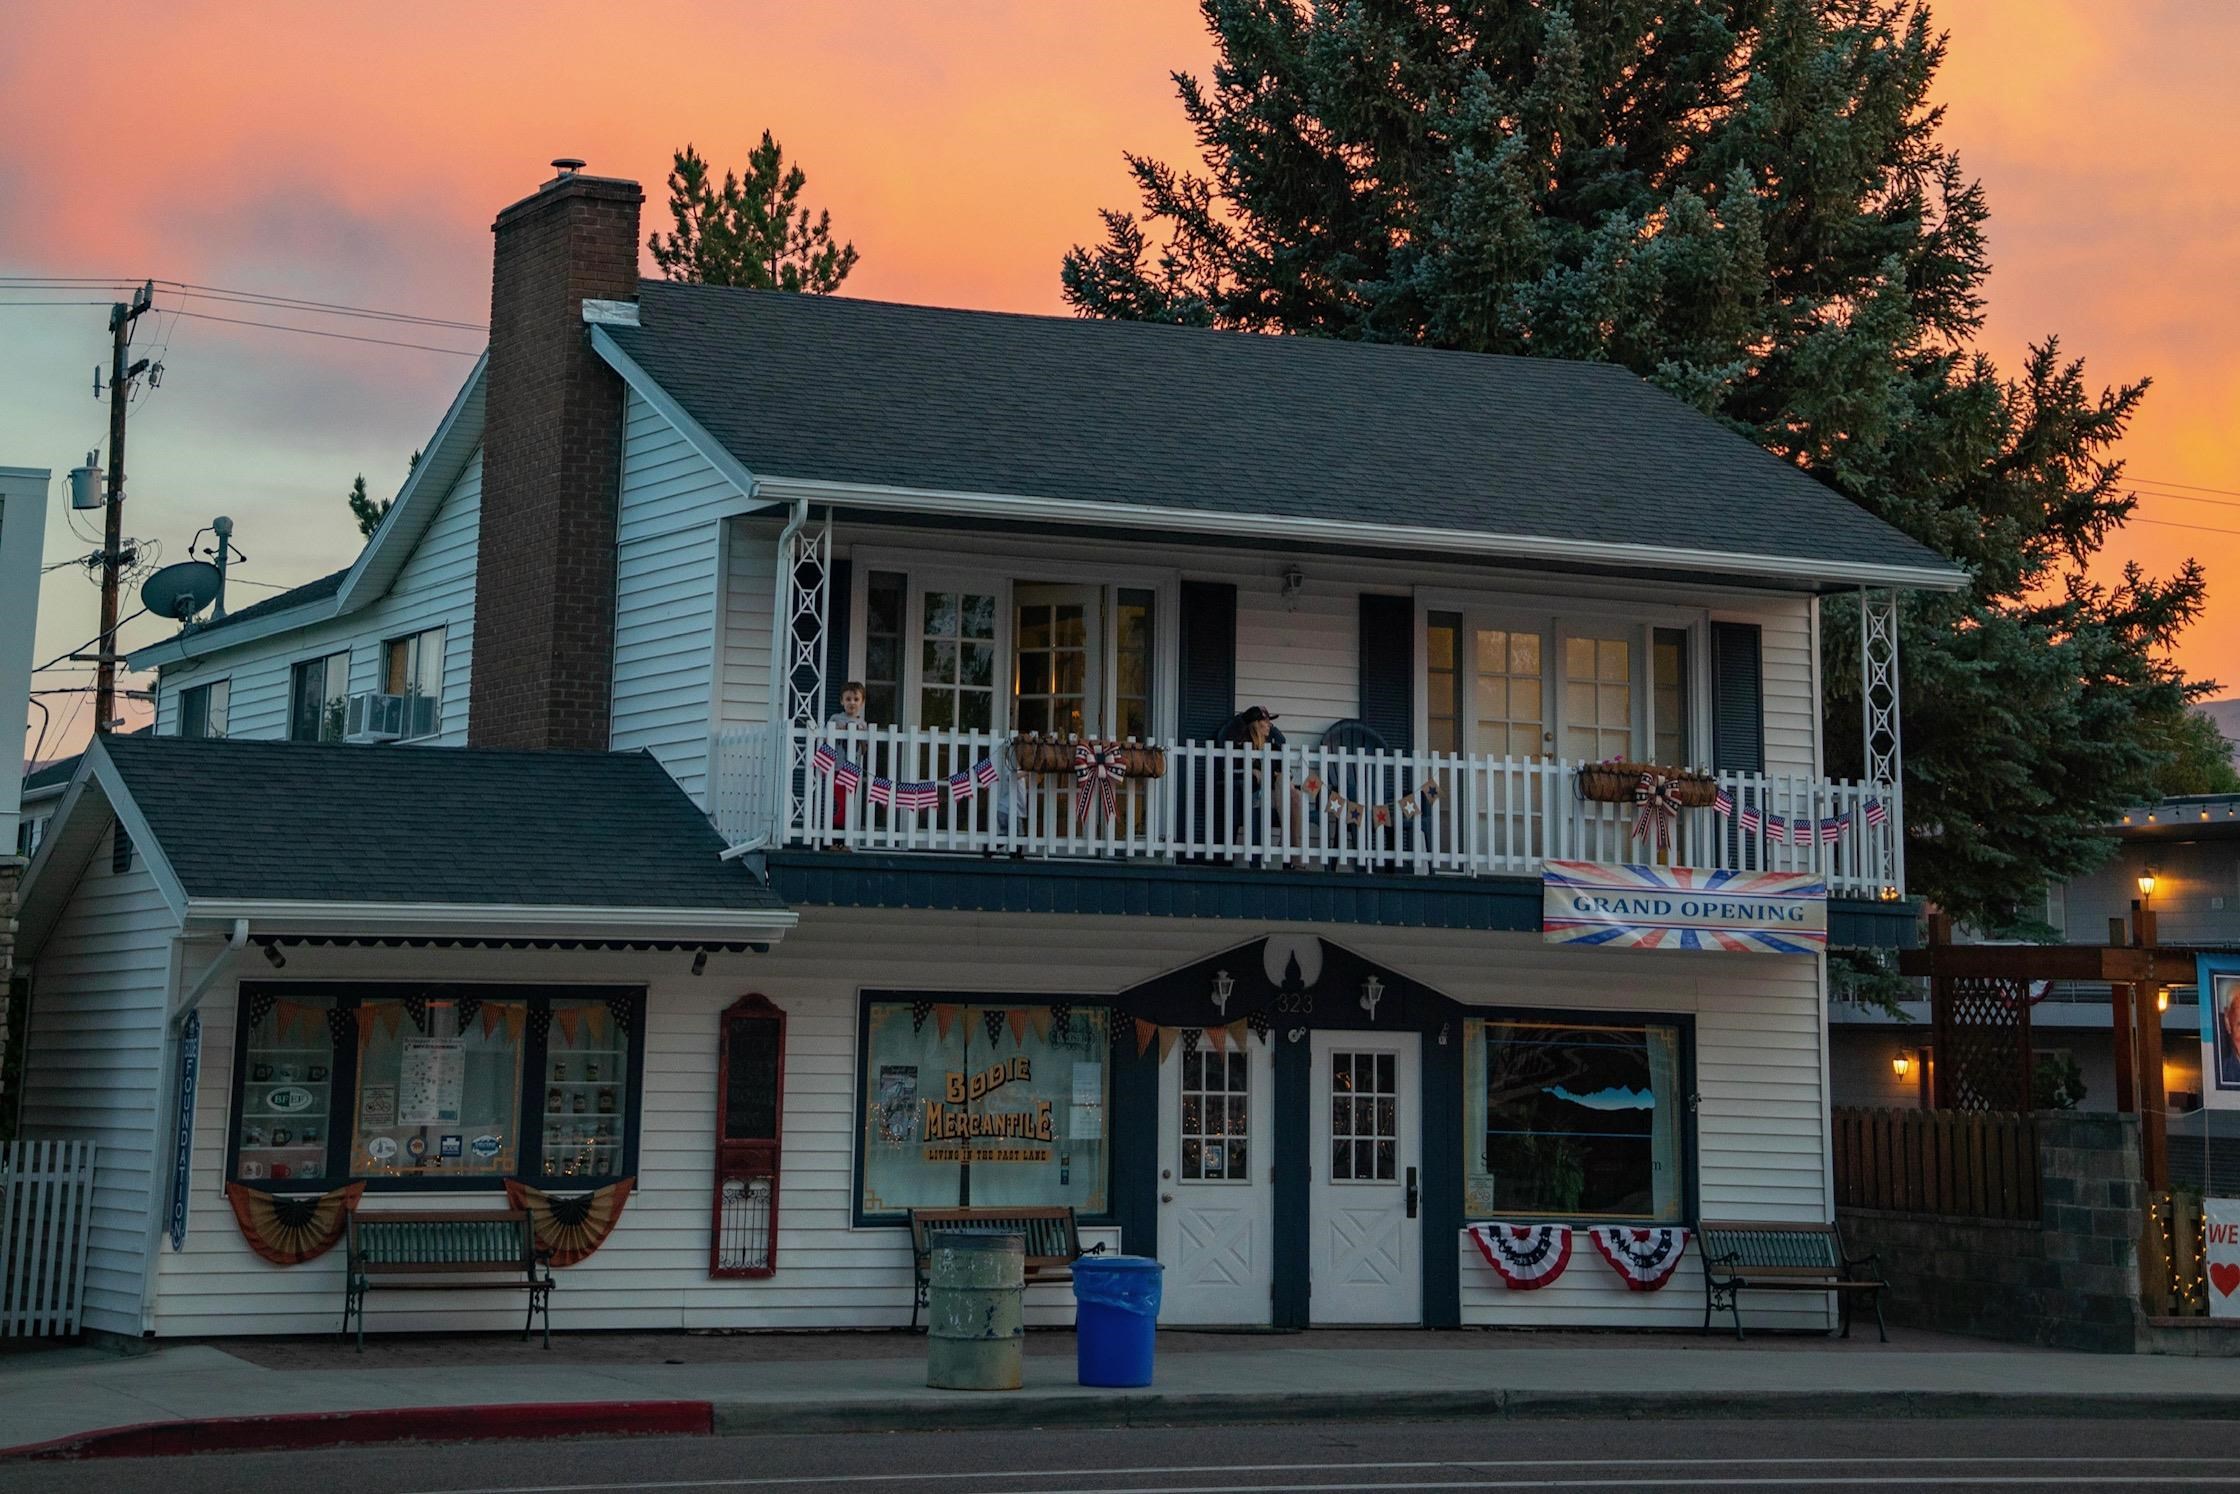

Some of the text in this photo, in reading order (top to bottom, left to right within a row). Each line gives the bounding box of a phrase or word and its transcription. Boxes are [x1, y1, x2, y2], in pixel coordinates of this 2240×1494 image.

[1574, 895, 1804, 922] GRAND OPENING
[1279, 994, 1313, 1013] 323
[945, 1056, 1031, 1105] BODIE
[924, 1100, 1052, 1142] MERCANTILE
[173, 1059, 193, 1237] FOUNDATION
[929, 1150, 1046, 1161] LIVING IN THE PAST LANE
[2208, 1223, 2239, 1244] WE
